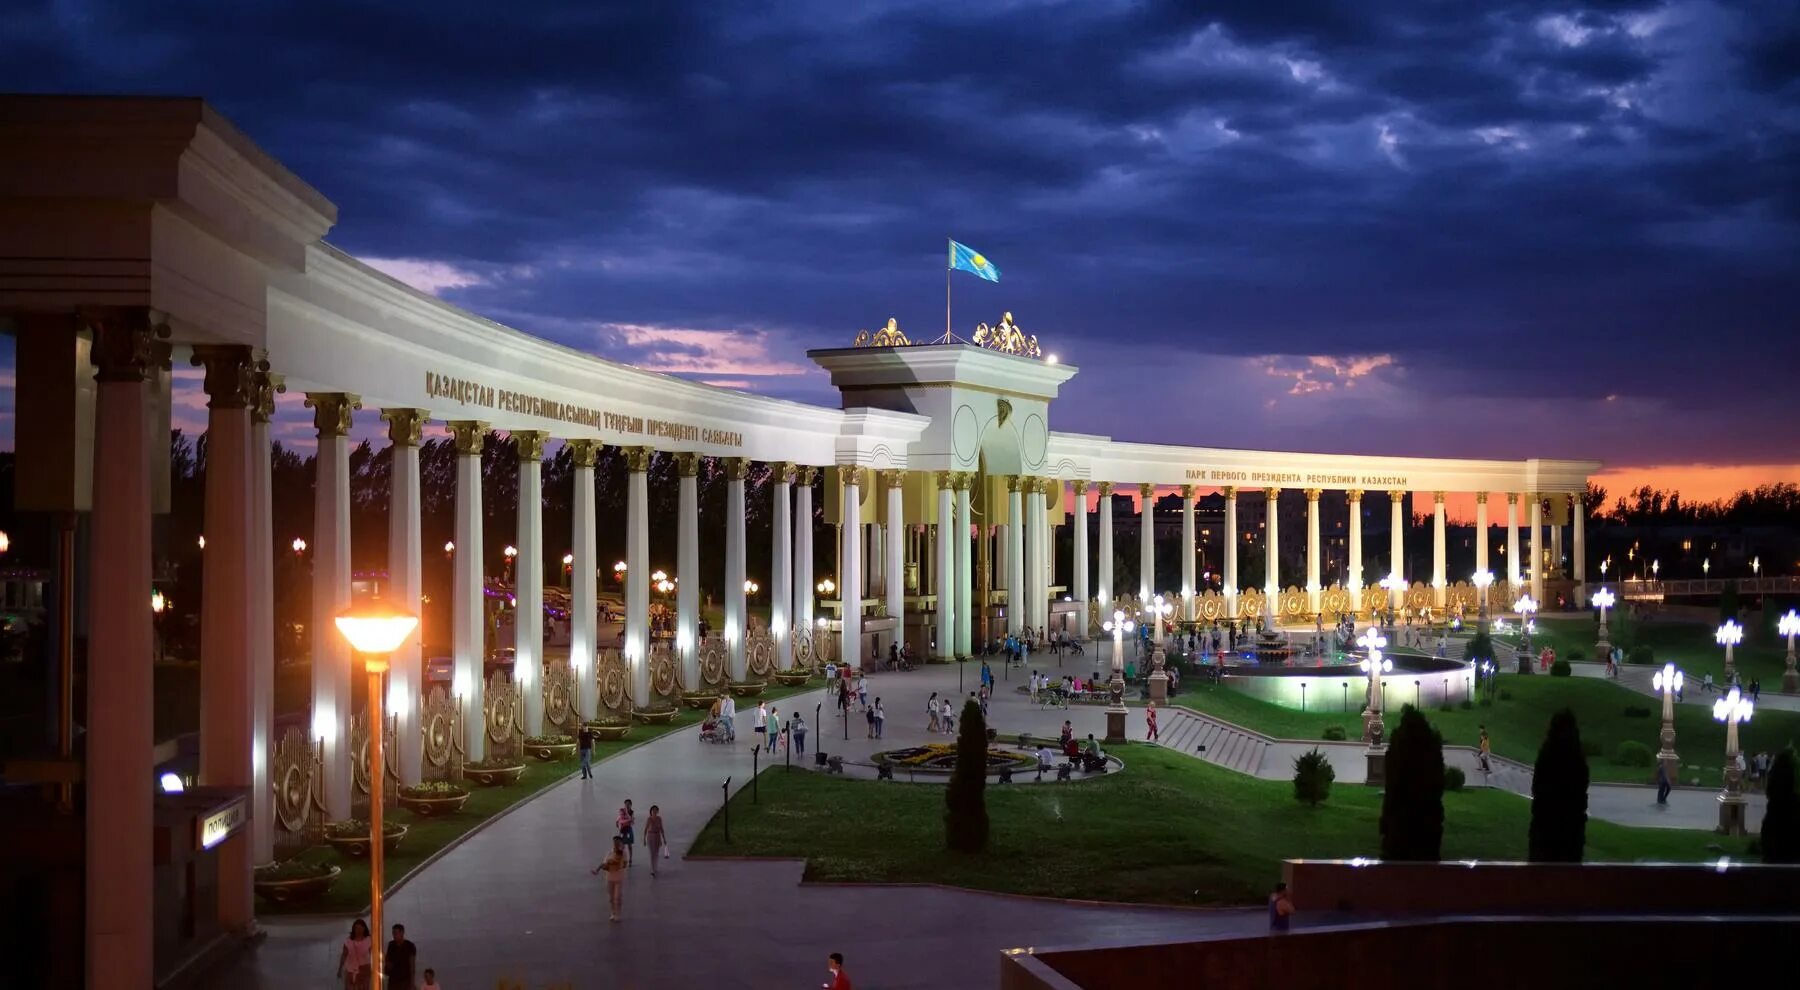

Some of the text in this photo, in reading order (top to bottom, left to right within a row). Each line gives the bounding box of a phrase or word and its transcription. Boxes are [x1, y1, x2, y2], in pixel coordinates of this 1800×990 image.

[1186, 469, 1407, 486] ПАРК ПЕРВОГО ПРЕЗИДЕНТА РЕСПУБЛИКИ КАЗАХСТАН
